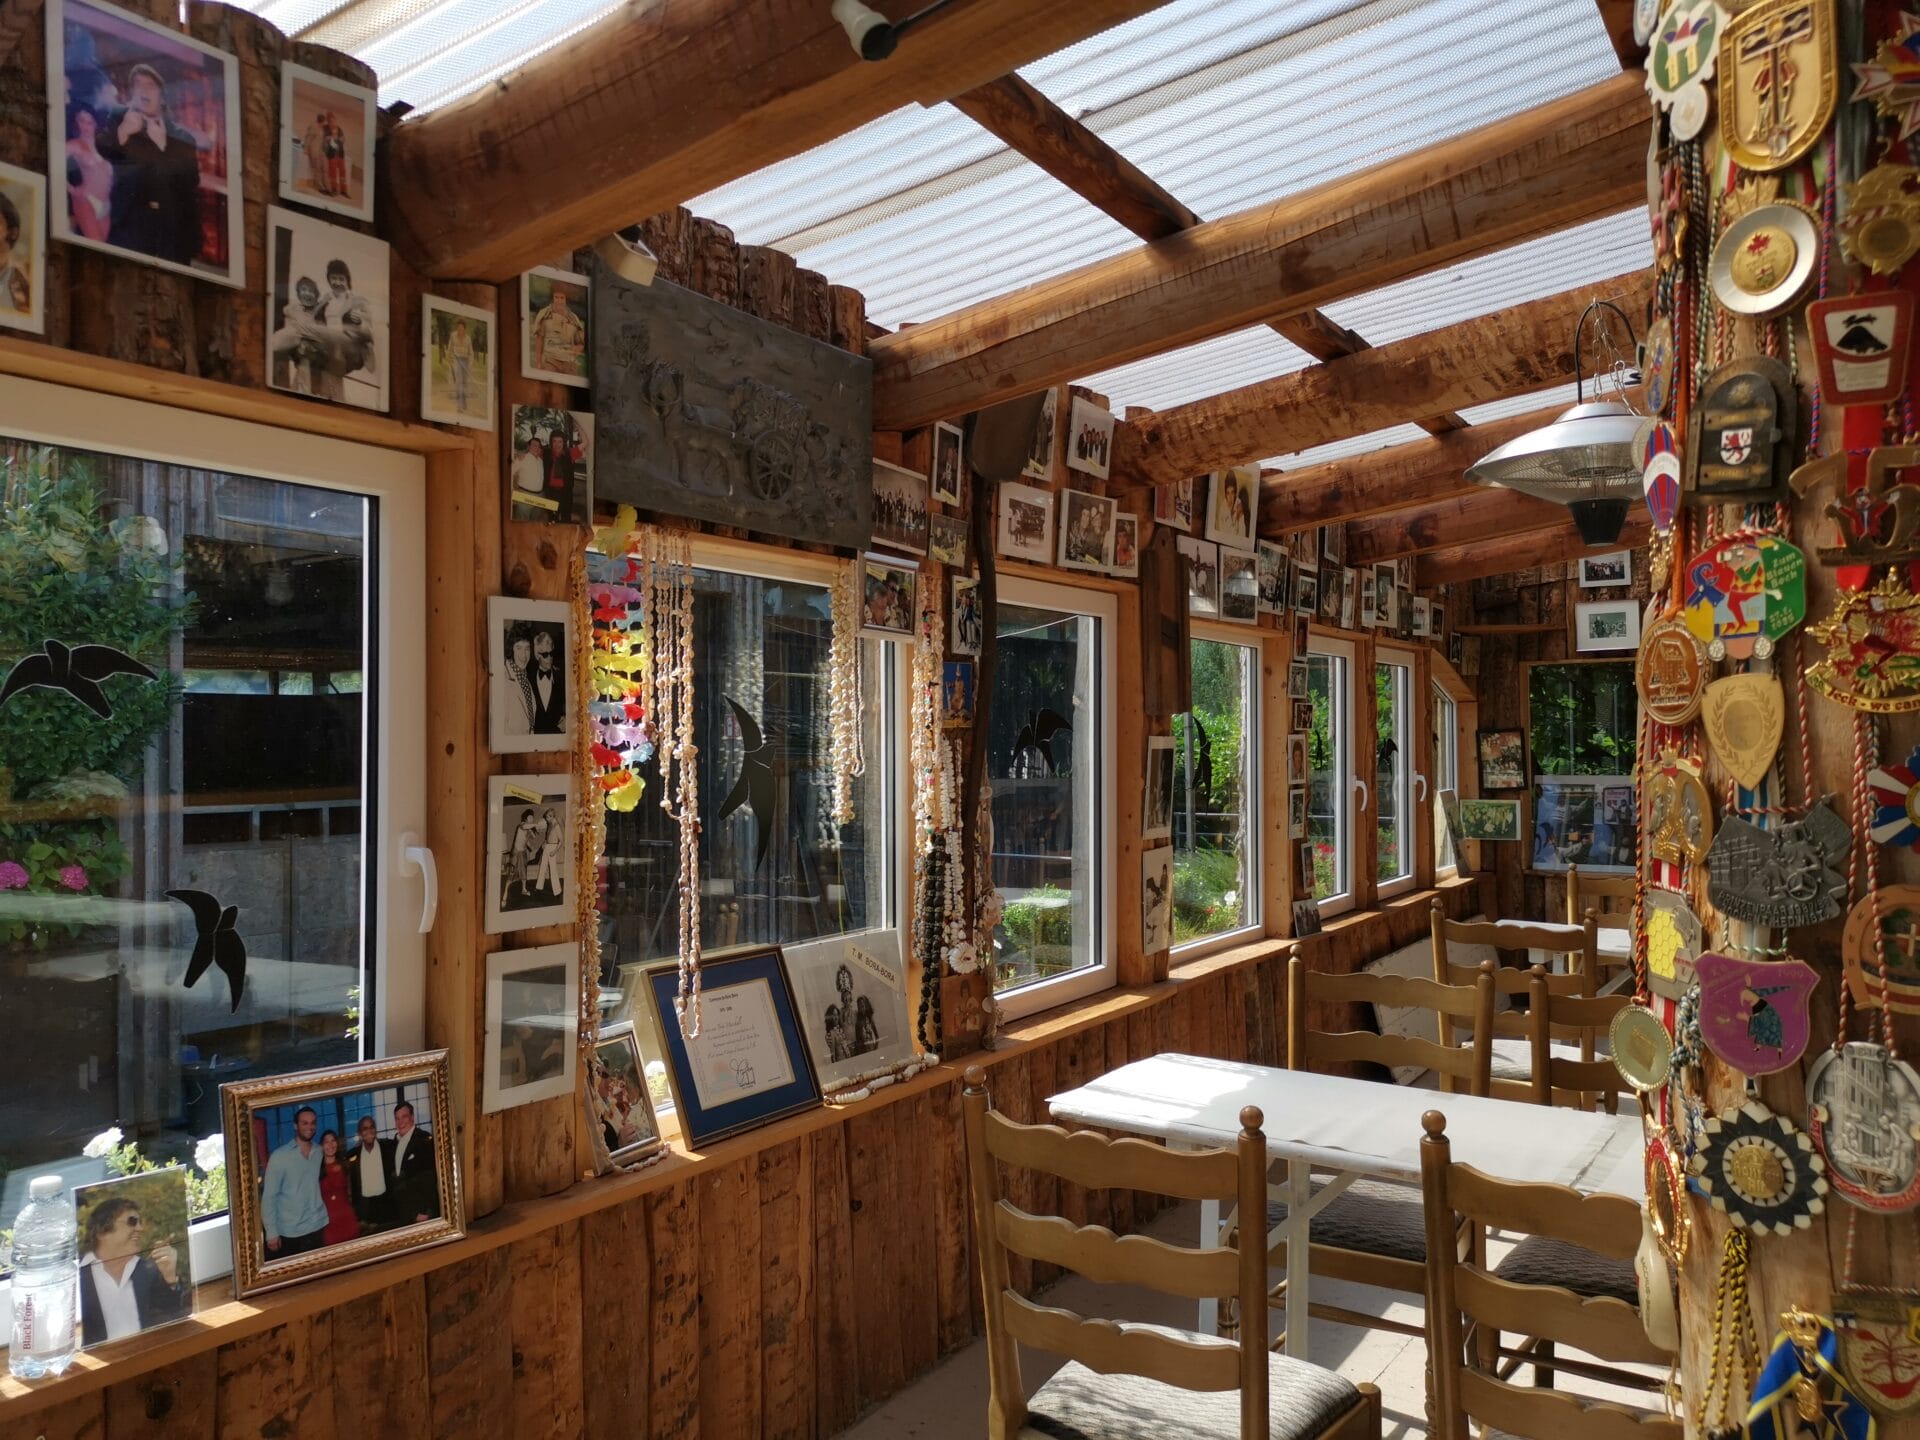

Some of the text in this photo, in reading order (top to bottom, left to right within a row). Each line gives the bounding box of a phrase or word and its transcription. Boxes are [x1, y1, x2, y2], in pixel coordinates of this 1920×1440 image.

[1869, 701, 1890, 711] we
[864, 956, 896, 985] BORA-BORA
[23, 1321, 32, 1350] Black
